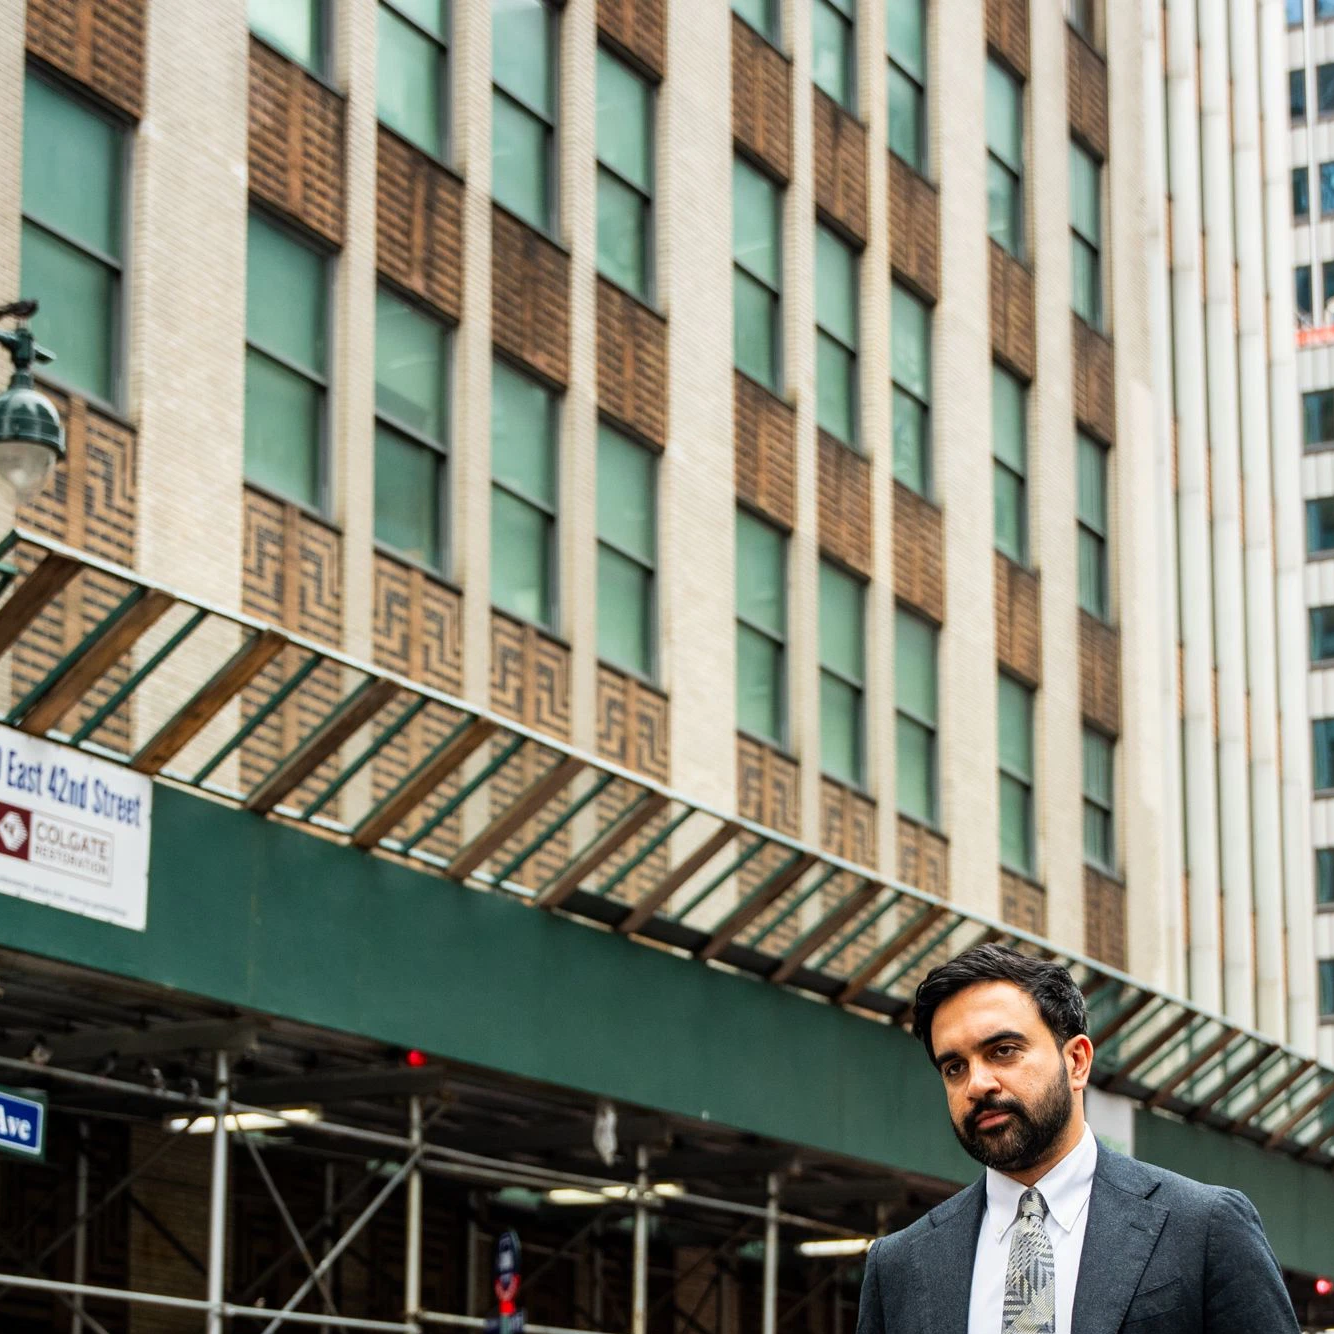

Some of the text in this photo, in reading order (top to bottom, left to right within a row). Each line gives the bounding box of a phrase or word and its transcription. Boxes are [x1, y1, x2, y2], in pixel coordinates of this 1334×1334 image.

[7, 750, 44, 796] East
[48, 763, 88, 810] 42nd
[92, 776, 141, 828] Street
[34, 845, 109, 876] RESTORATION
[35, 821, 109, 862] COLGATE
